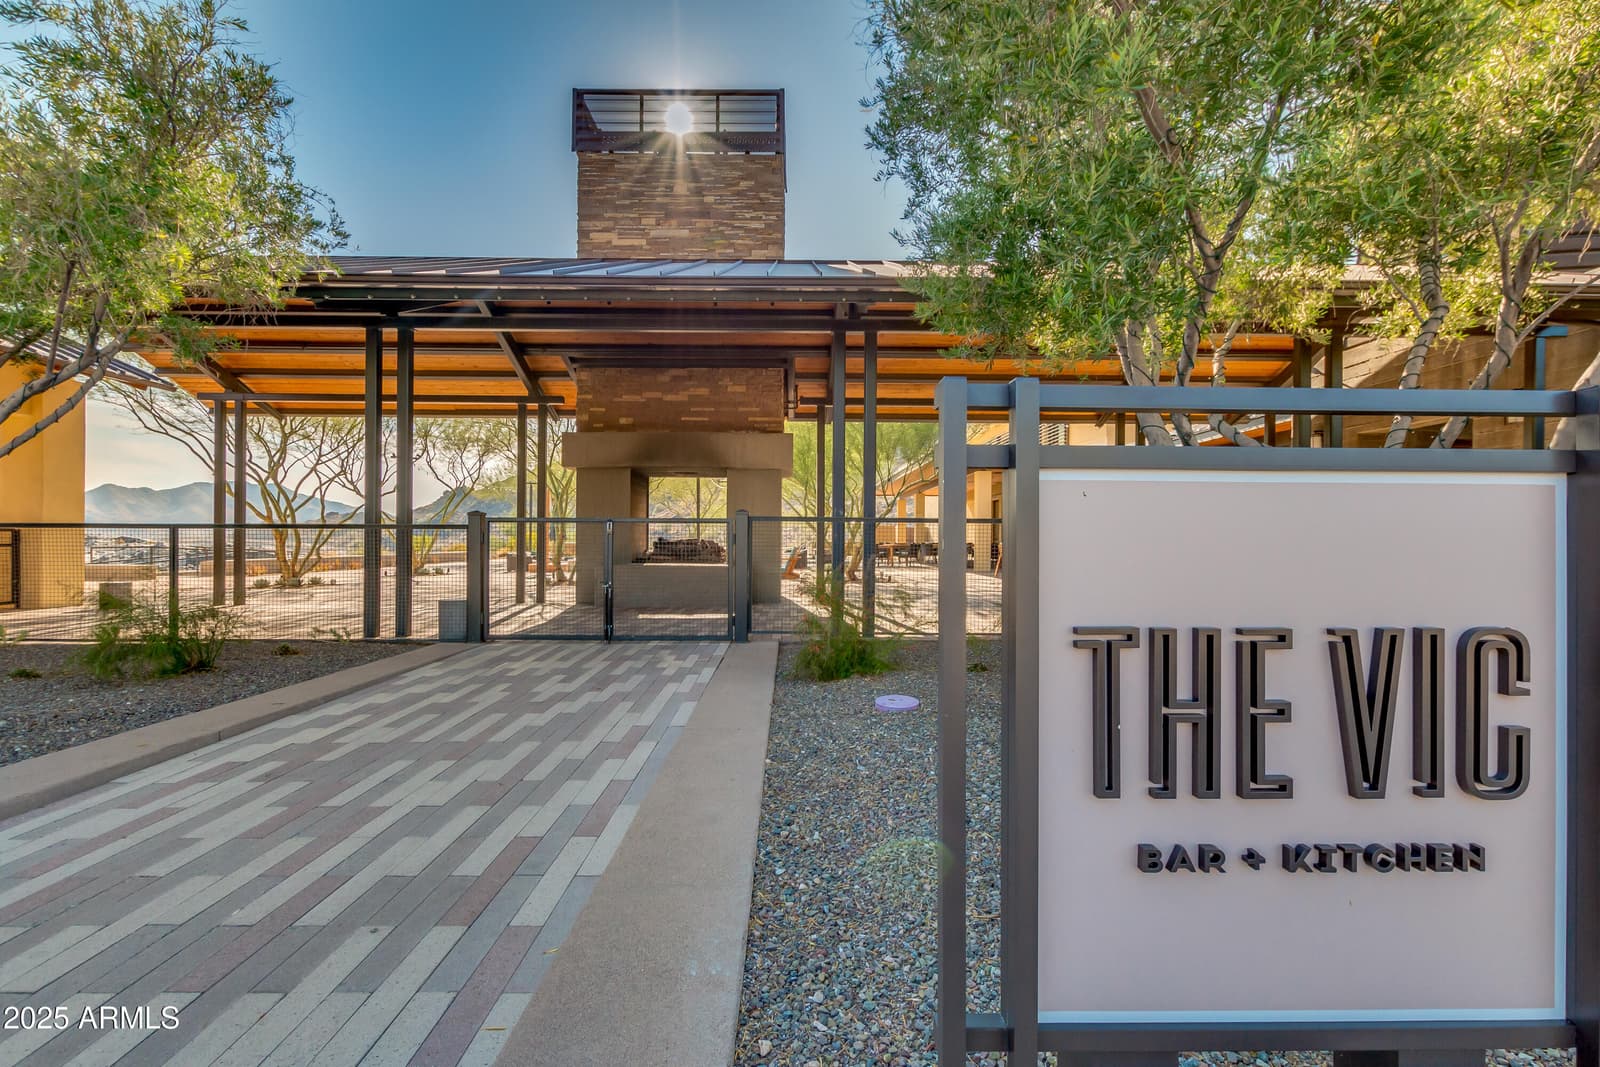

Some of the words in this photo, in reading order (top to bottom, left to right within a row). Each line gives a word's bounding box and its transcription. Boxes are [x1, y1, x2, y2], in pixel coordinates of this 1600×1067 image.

[1071, 626, 1294, 800] THE
[1325, 626, 1531, 801] VIC
[1137, 843, 1226, 873] BAR
[1281, 842, 1486, 873] KITCHEN
